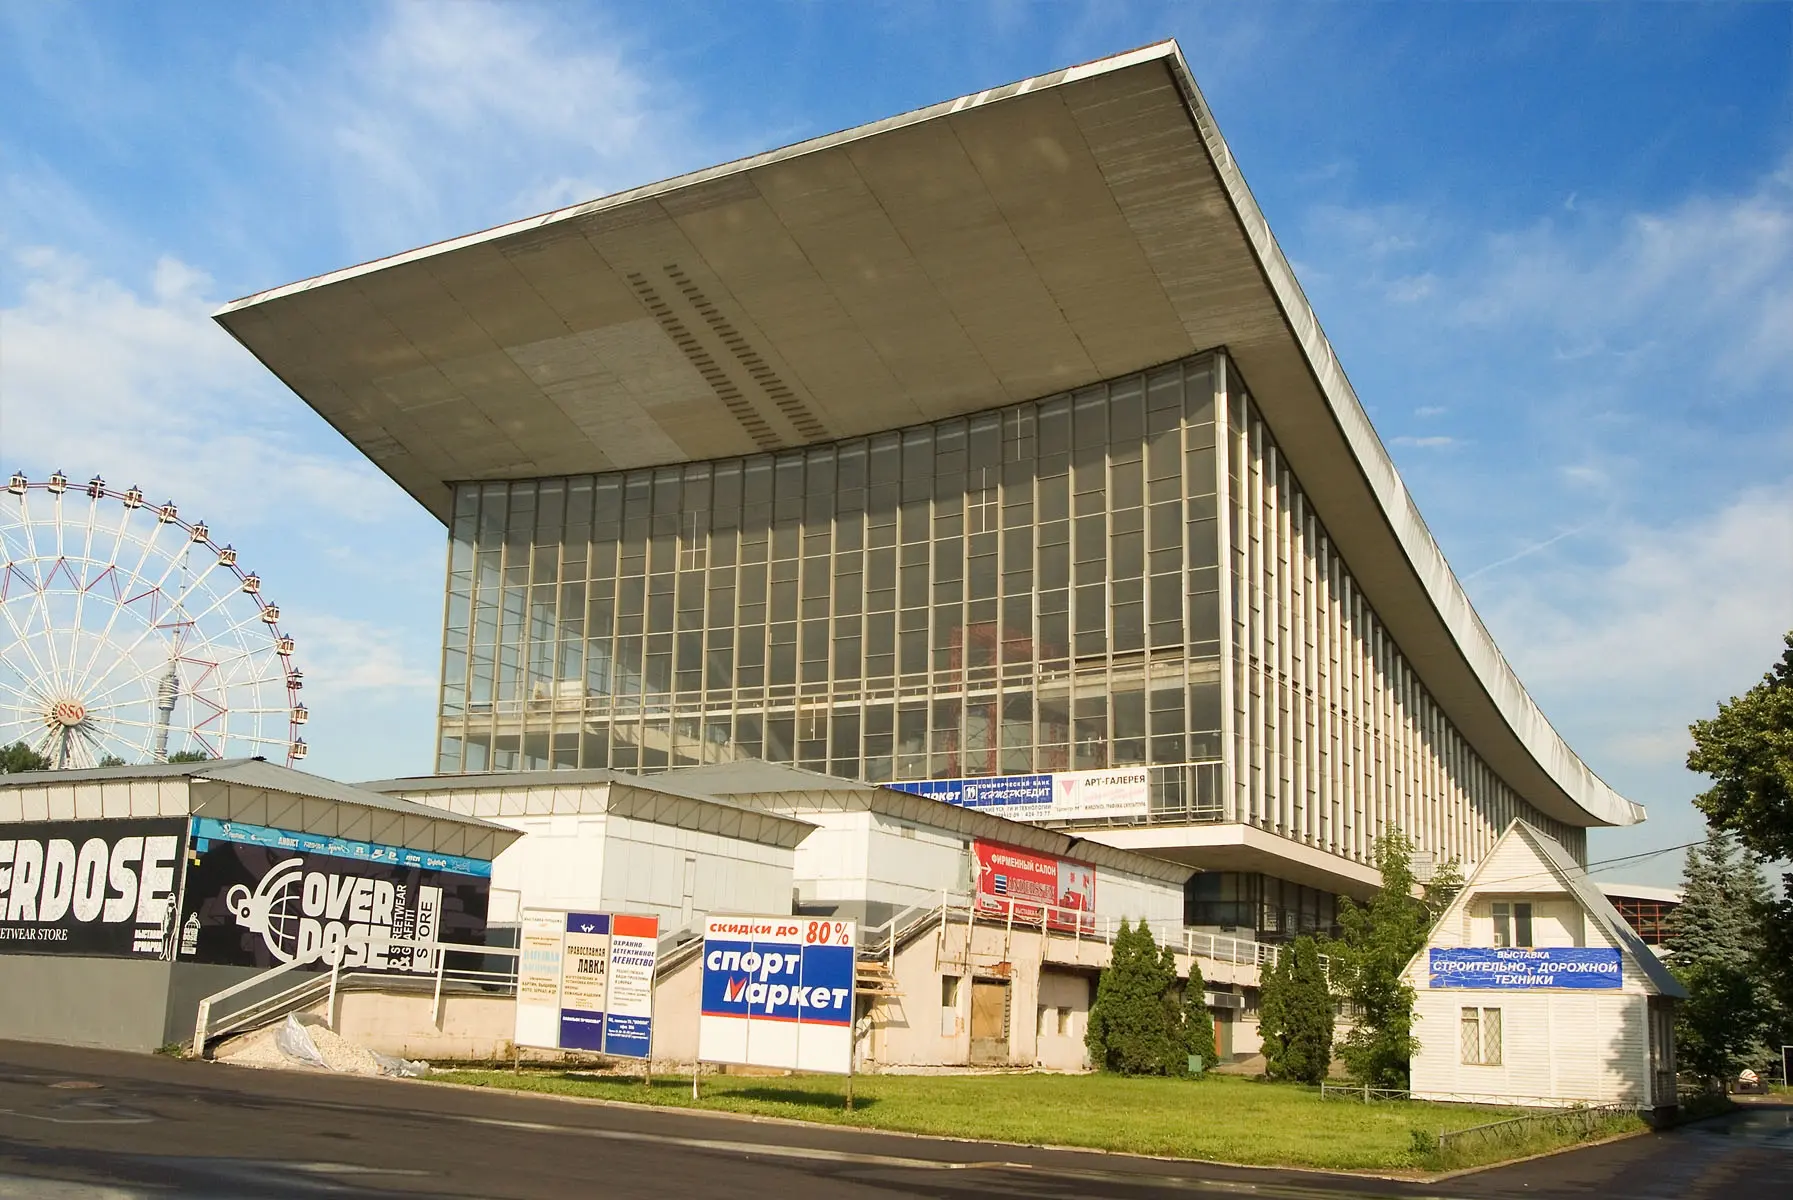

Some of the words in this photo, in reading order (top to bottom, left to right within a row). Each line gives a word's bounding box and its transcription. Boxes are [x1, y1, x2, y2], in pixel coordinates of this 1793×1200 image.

[58, 703, 84, 720] 850
[978, 780, 1030, 788] КОММЕРЧЕСКИЙ
[1085, 774, 1145, 786] АРТ-ГАЛЕРЕЯ
[992, 854, 1034, 870] ФИРМЕННЫЙ
[1035, 864, 1056, 876] САЛОН
[302, 872, 394, 924] OVER
[390, 884, 407, 954] SREETWEAR
[38, 928, 68, 941] STORE
[402, 909, 416, 955] GAFFITI
[416, 901, 433, 958] SORE
[297, 918, 392, 970] DOSE
[567, 945, 606, 957] ПРАВОСЛАВНАЯ
[613, 948, 655, 957] ДЕТЕКТИВНОЕ
[1497, 951, 1550, 959] ВЫСТАВКА
[577, 958, 605, 974] ЛАВКА
[612, 955, 654, 967] АГЕНТСТВО
[1538, 961, 1618, 973] ДОРОЖНОЙ
[1495, 975, 1554, 985] ТЕХНИКИ
